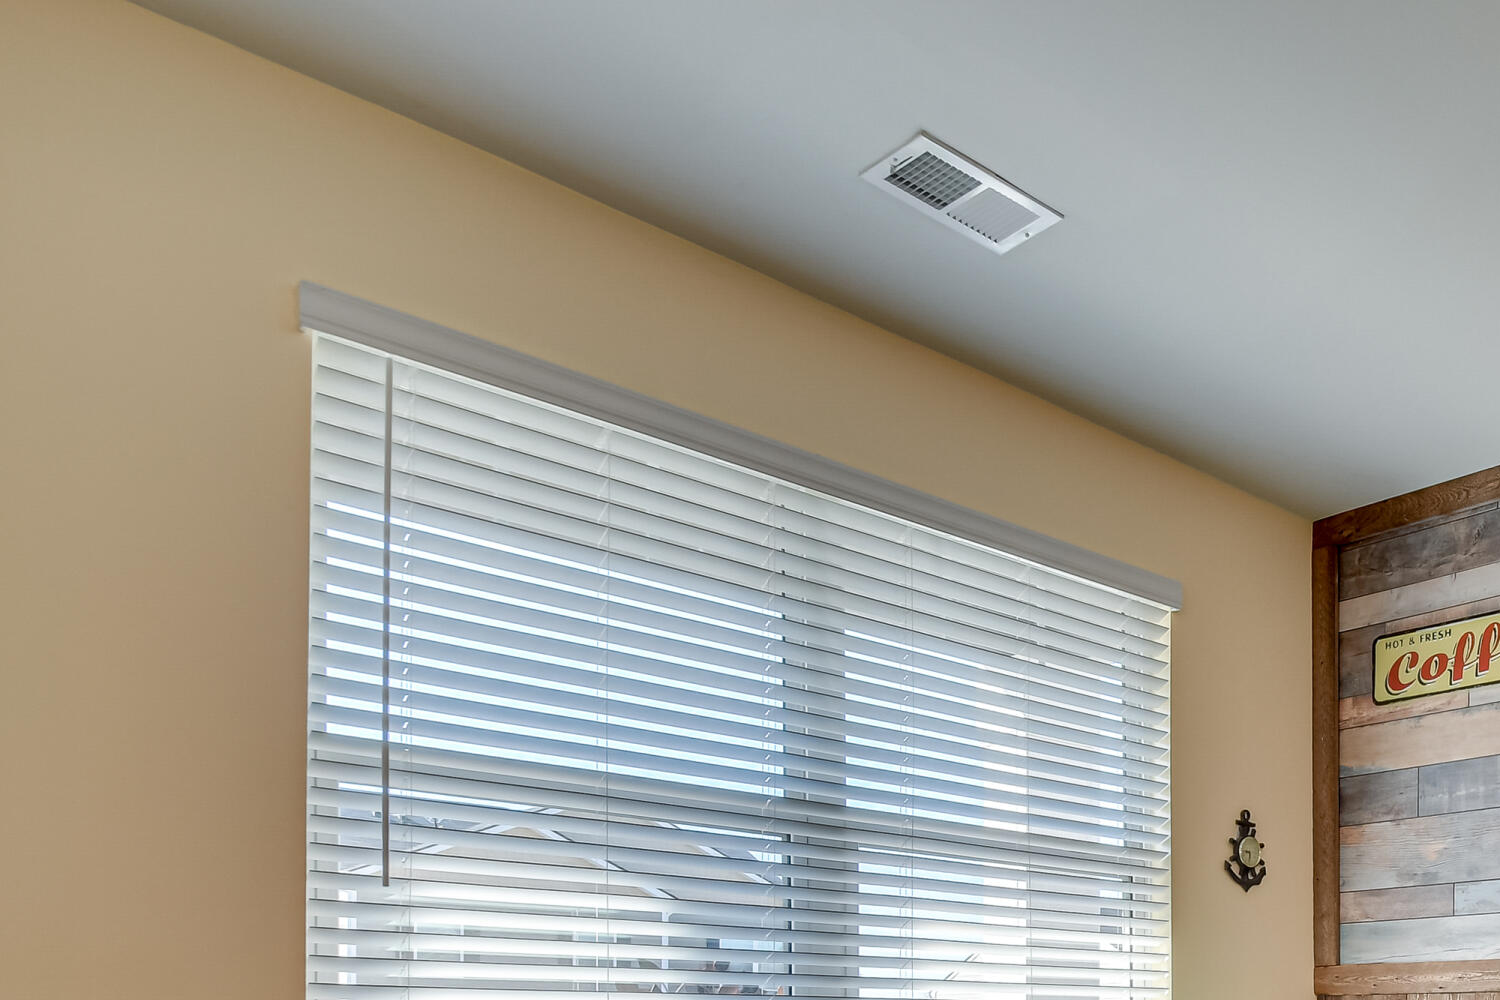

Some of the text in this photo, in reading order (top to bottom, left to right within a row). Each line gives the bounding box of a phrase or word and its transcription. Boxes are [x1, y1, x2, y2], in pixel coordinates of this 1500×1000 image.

[1385, 629, 1451, 650] HOT & FRESH
